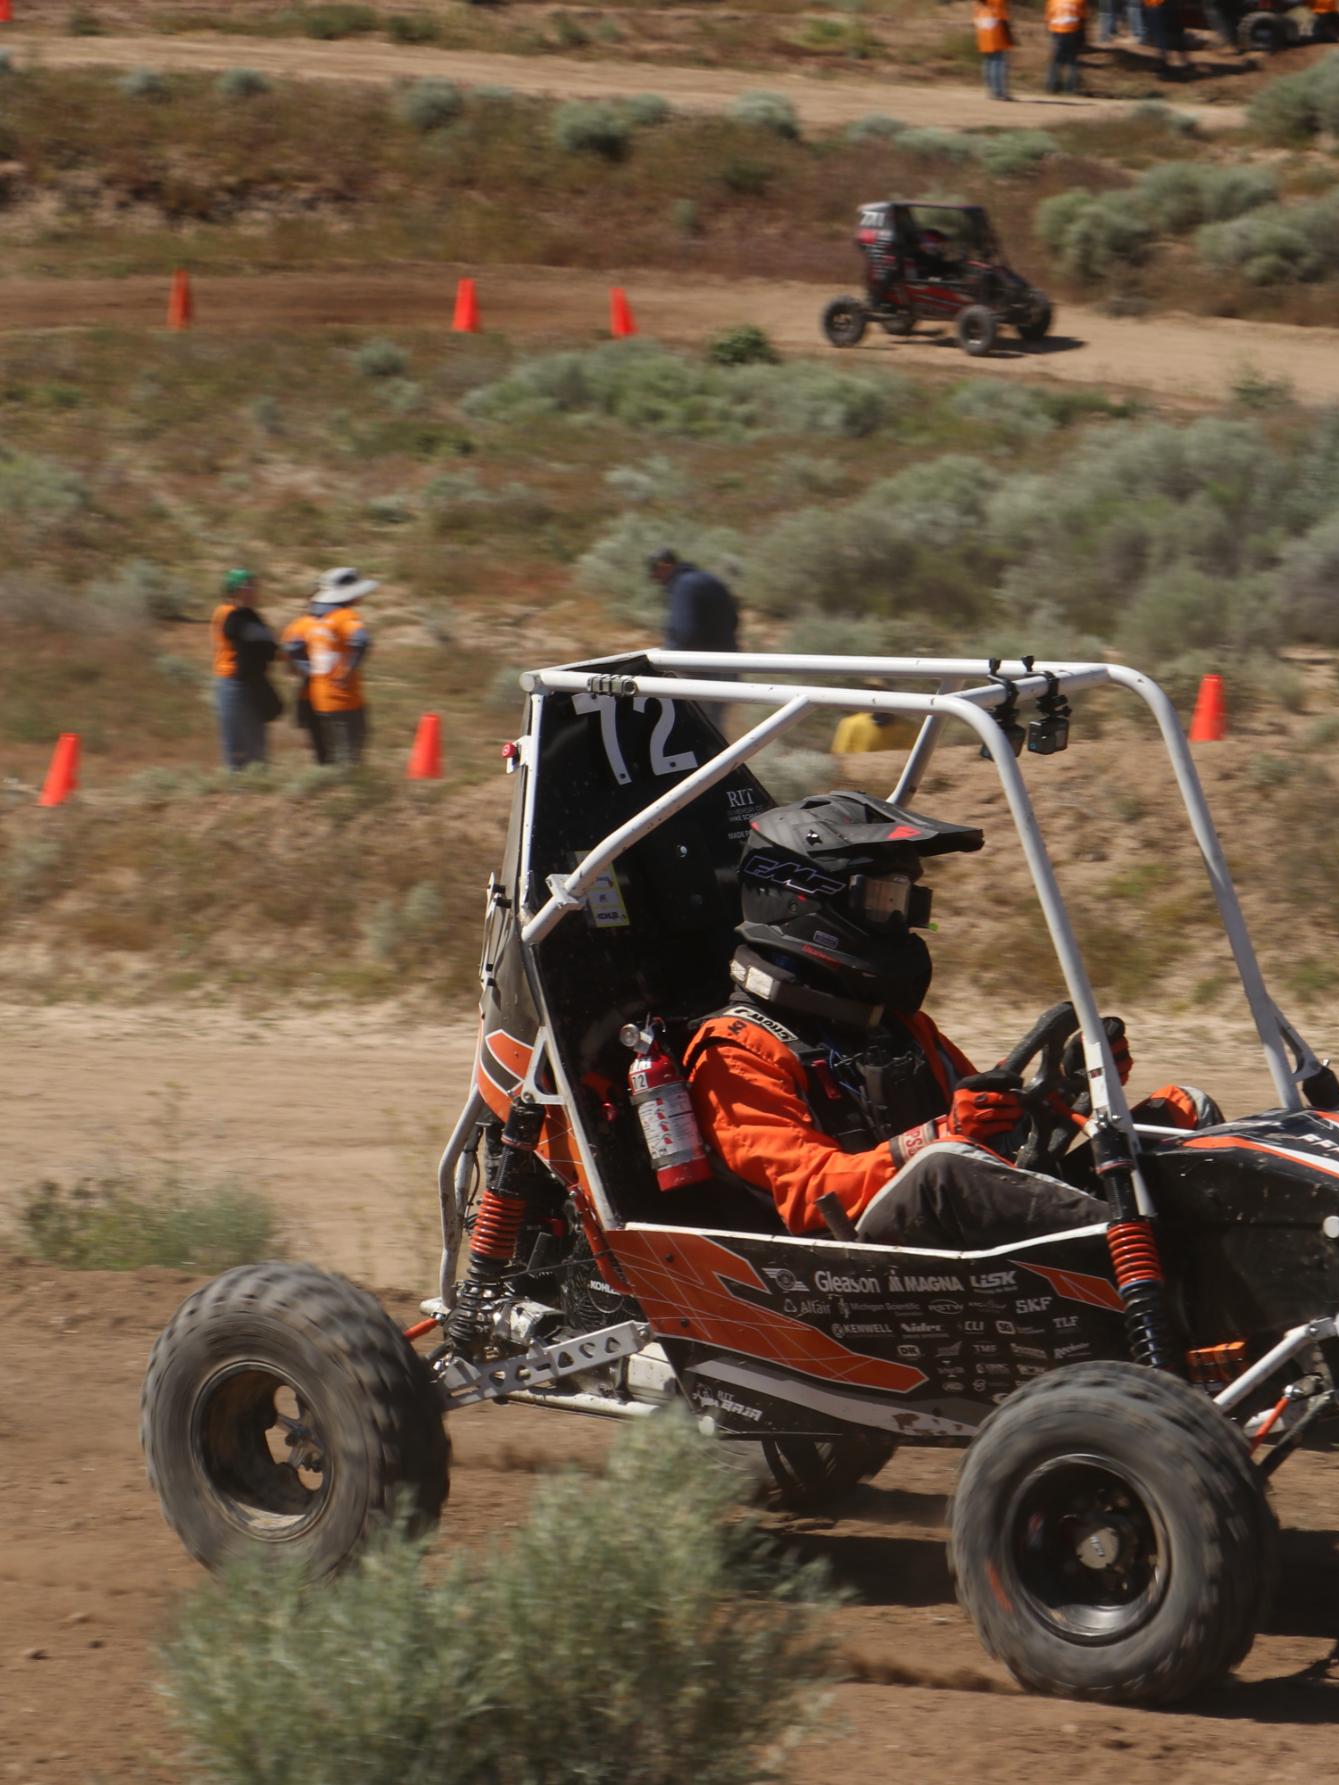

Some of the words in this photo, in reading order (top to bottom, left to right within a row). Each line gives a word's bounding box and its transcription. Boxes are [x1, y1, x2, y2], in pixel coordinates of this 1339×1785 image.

[572, 692, 699, 785] 72
[726, 788, 754, 807] RIT
[814, 1270, 881, 1294] Gleason
[904, 1276, 965, 1292] MAGNA
[1015, 1297, 1053, 1314] SKF
